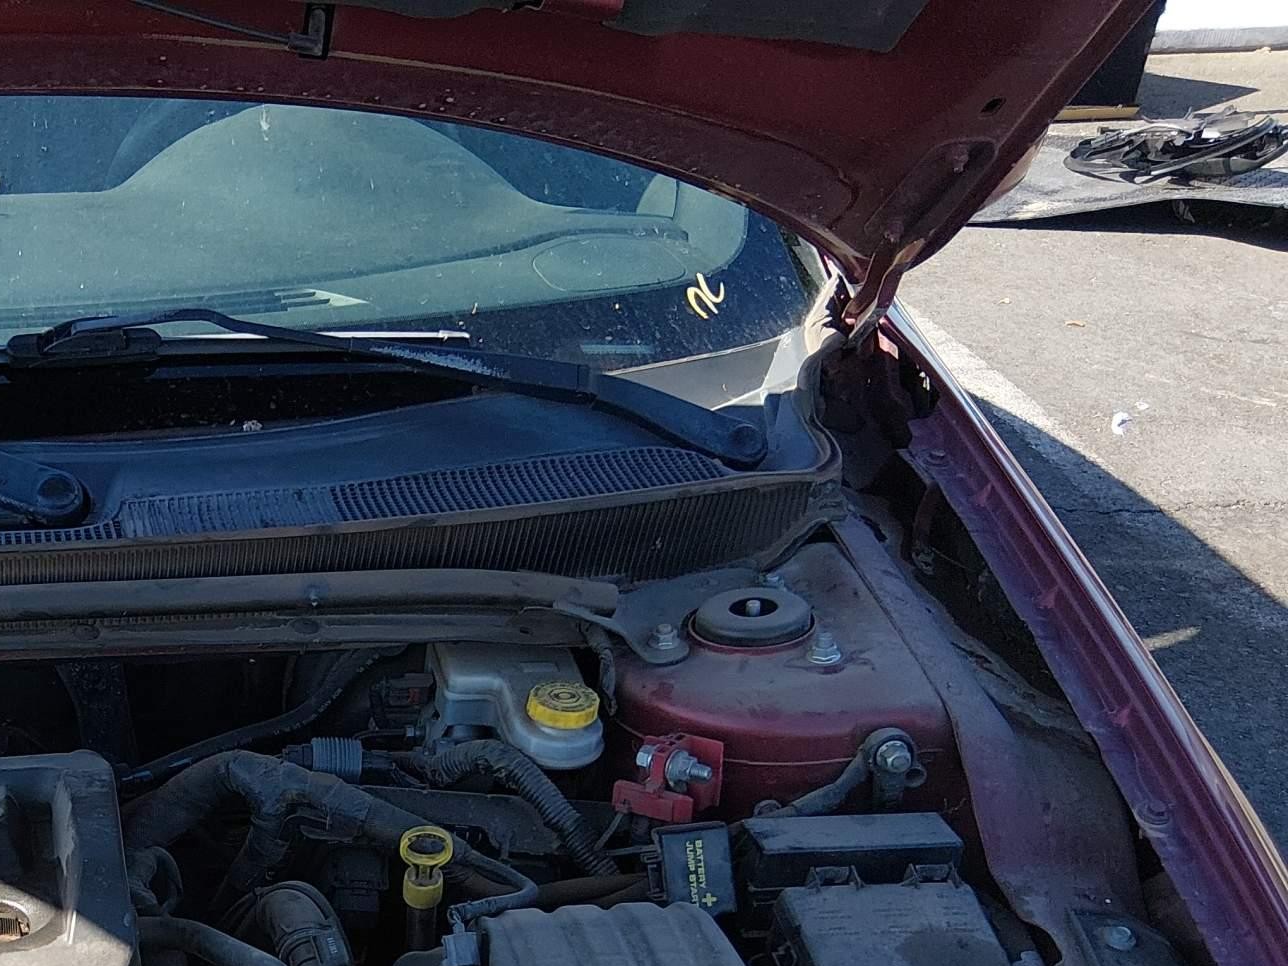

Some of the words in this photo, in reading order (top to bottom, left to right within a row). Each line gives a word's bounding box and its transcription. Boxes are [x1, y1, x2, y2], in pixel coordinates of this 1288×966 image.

[686, 841, 695, 871] JUMP
[695, 840, 706, 888] BATTERY
[689, 874, 699, 907] START
